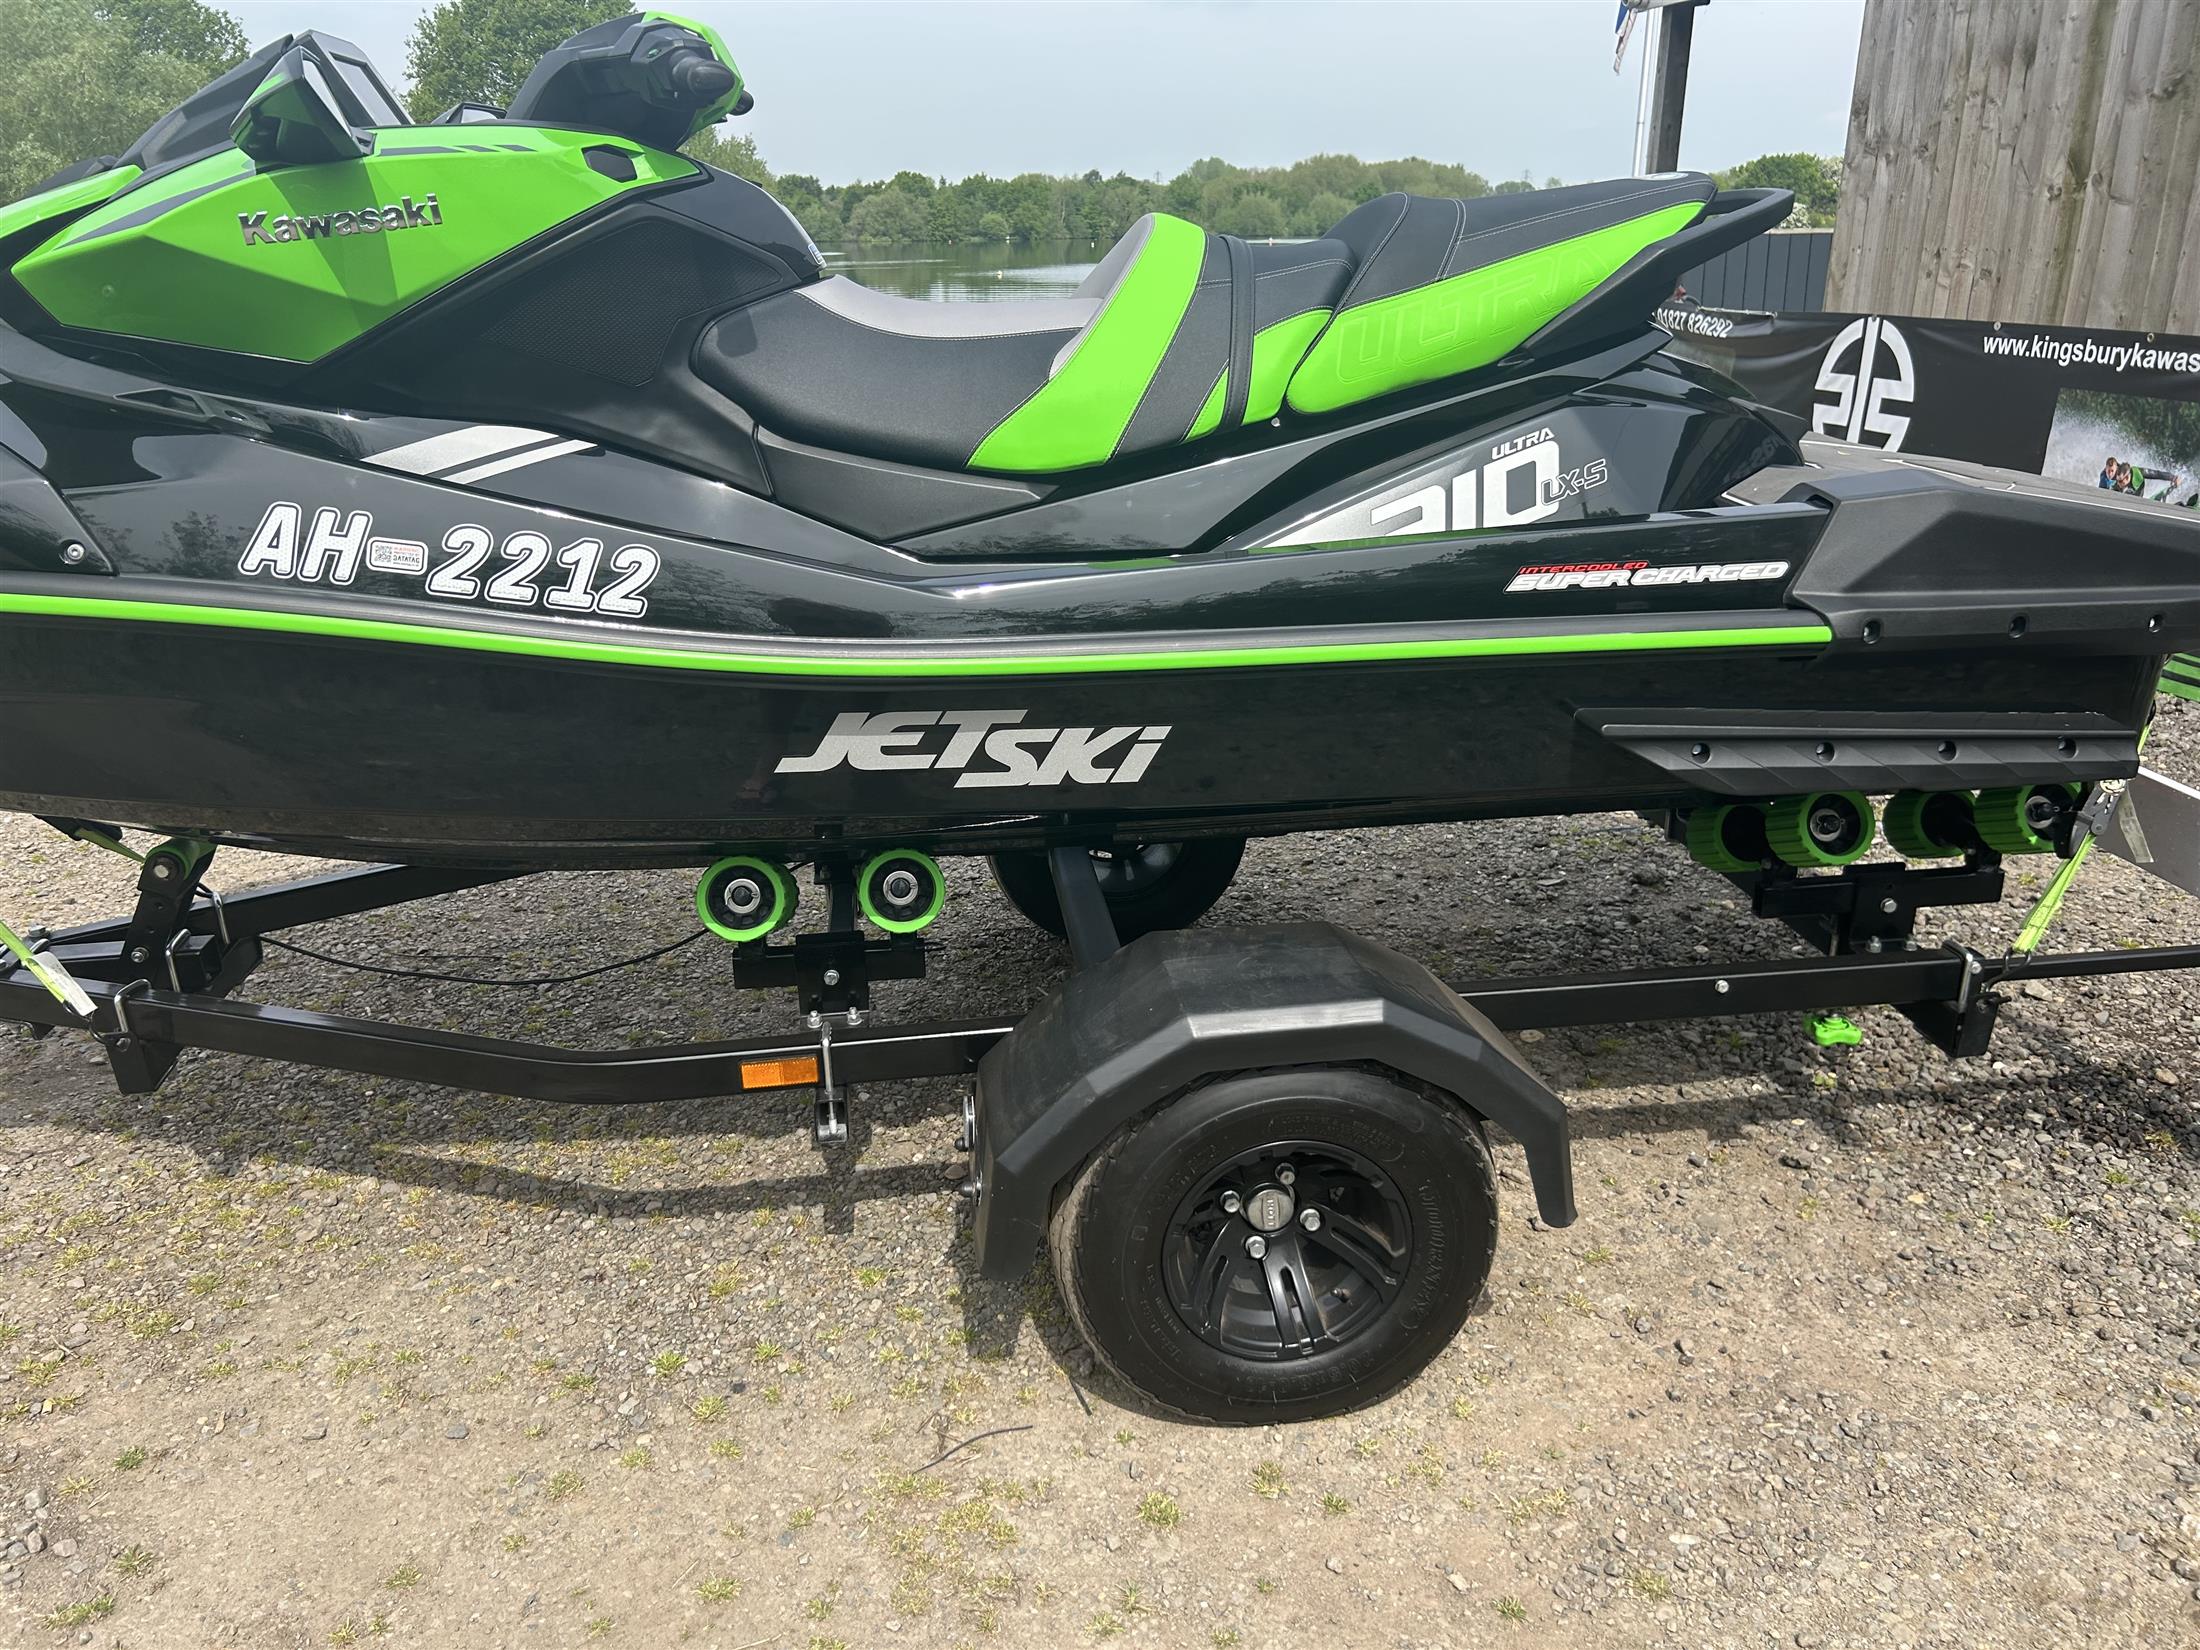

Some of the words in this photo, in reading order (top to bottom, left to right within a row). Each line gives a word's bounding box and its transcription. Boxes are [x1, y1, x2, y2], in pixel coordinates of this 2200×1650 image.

[237, 193, 443, 246] Kawasaki
[1687, 312, 1734, 338] 826292
[1491, 427, 1555, 460] ULTRA
[1541, 458, 1608, 506] LX-S
[1506, 569, 1632, 592] SUPER
[1631, 562, 1789, 586] CHARGED
[1520, 562, 1648, 574] INTERCOOLED
